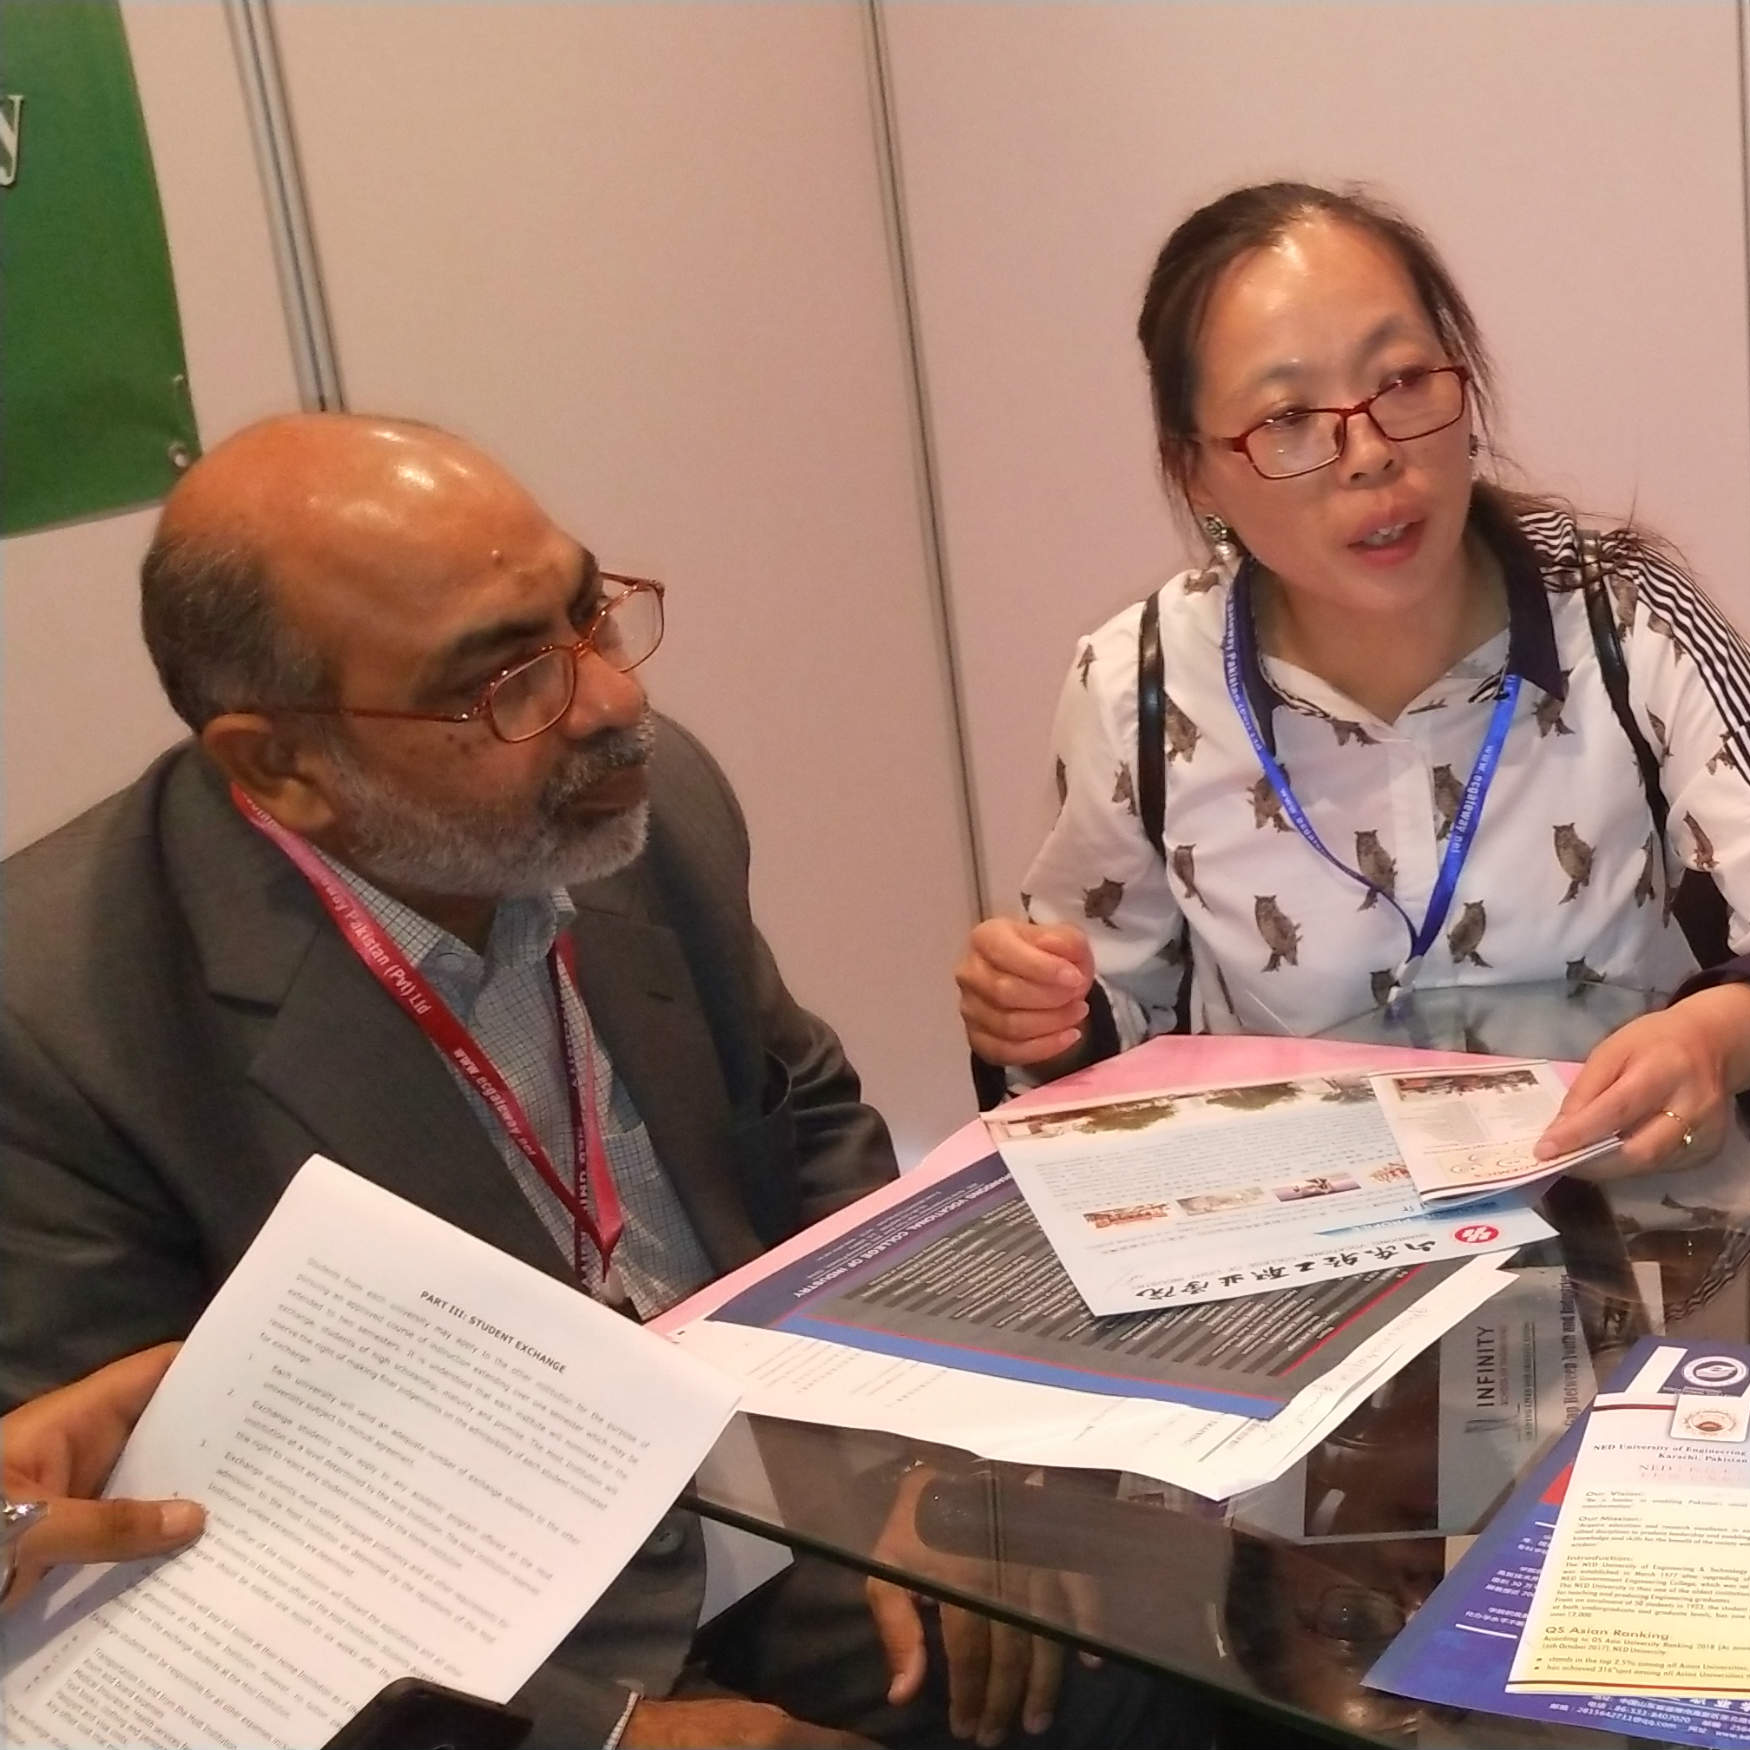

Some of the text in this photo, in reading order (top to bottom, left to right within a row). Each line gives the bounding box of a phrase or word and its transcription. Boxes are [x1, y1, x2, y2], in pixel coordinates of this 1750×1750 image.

[339, 906, 394, 969] Pakistan
[419, 1289, 447, 1309] PART
[467, 1314, 514, 1345] STUDENT
[513, 1339, 567, 1374] EXCHANGE
[1476, 1325, 1495, 1407] INFINITY
[1593, 1442, 1616, 1450] NED
[1619, 1442, 1669, 1452] University
[1685, 1445, 1746, 1457] Engineering
[1544, 1624, 1670, 1642] QS Asian Ranking
